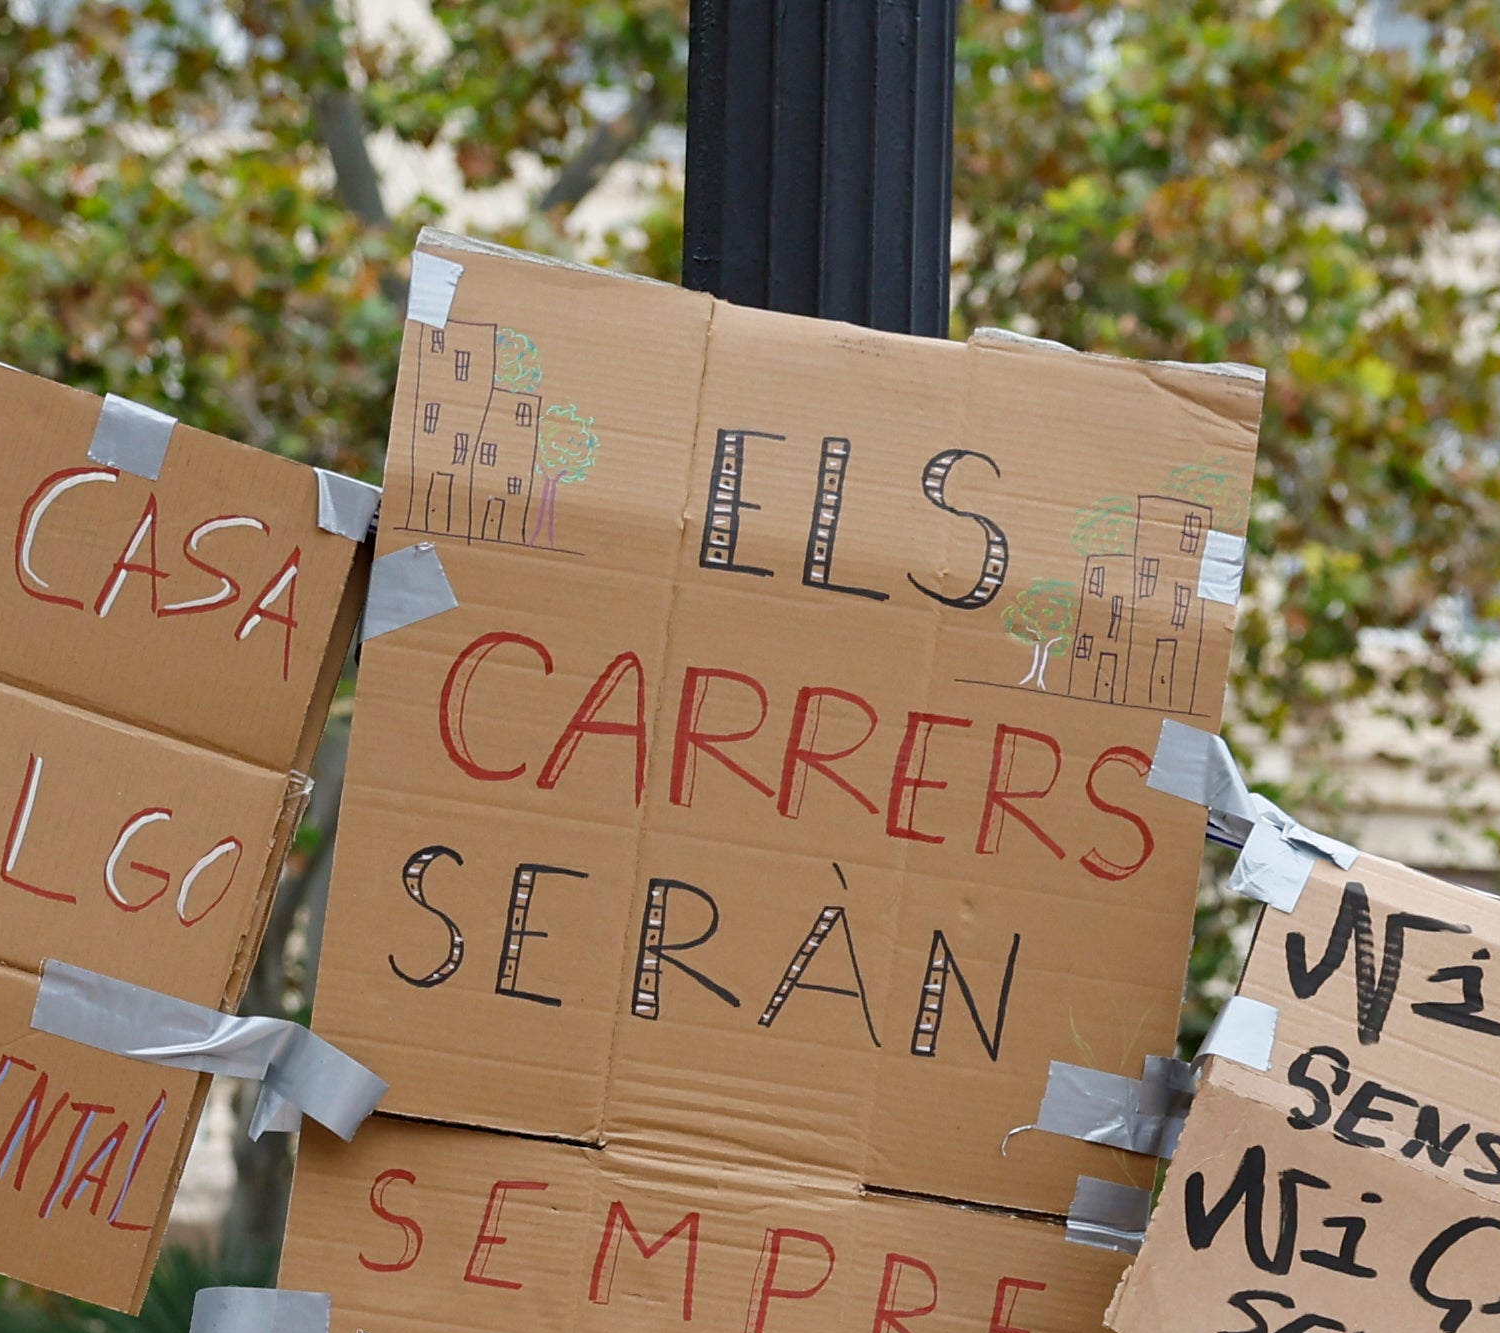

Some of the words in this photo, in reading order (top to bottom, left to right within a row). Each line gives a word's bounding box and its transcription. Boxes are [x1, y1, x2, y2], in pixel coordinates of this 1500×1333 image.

[13, 465, 302, 682] CASA
[699, 427, 1009, 609] ELS
[439, 630, 1155, 881] CARRERS
[388, 845, 1020, 1063] SERÀN
